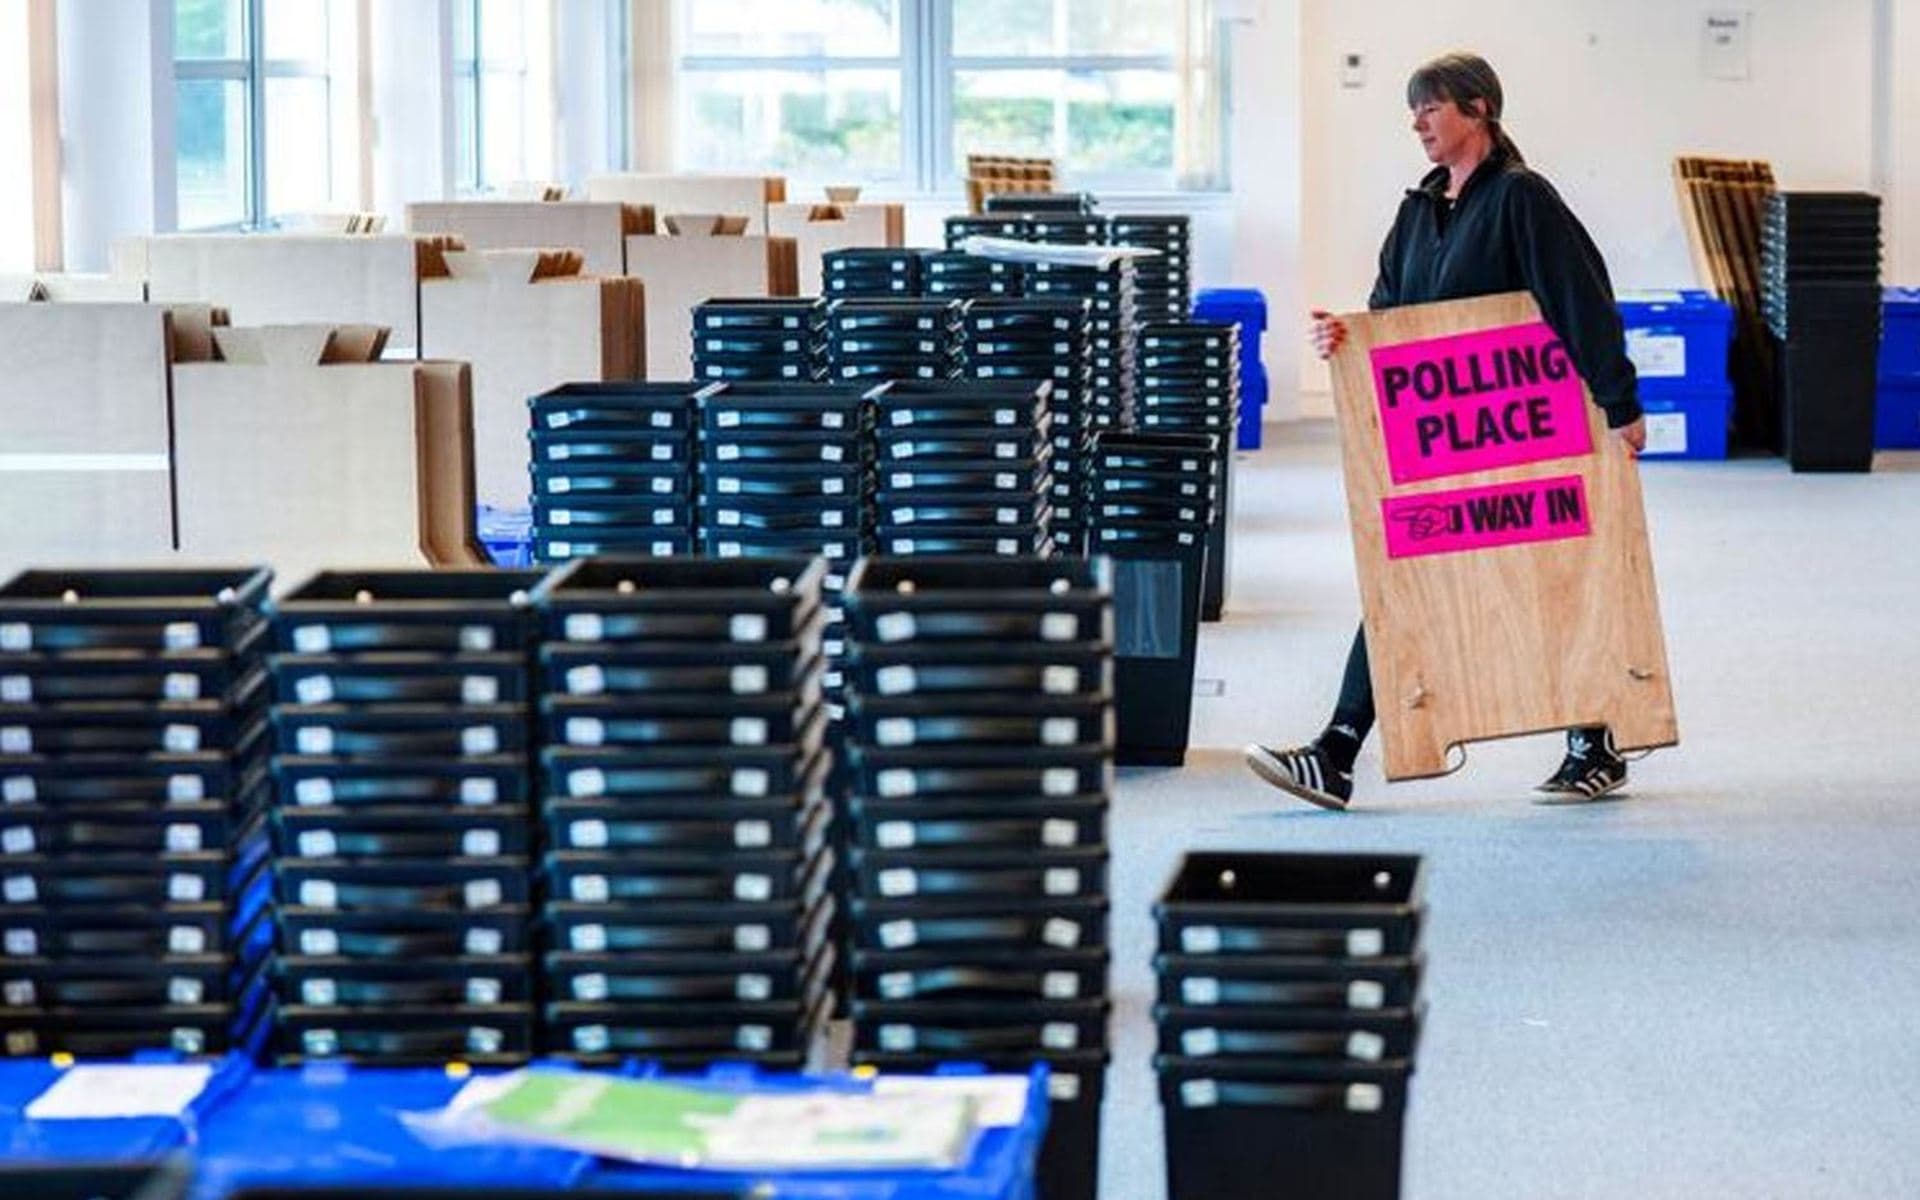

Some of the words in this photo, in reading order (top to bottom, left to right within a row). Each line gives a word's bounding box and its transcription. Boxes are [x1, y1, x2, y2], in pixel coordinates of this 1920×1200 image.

[1383, 341, 1568, 408] POLLING
[1417, 397, 1555, 456] PLACE
[1468, 491, 1535, 533] WAY
[1546, 487, 1581, 523] IN
